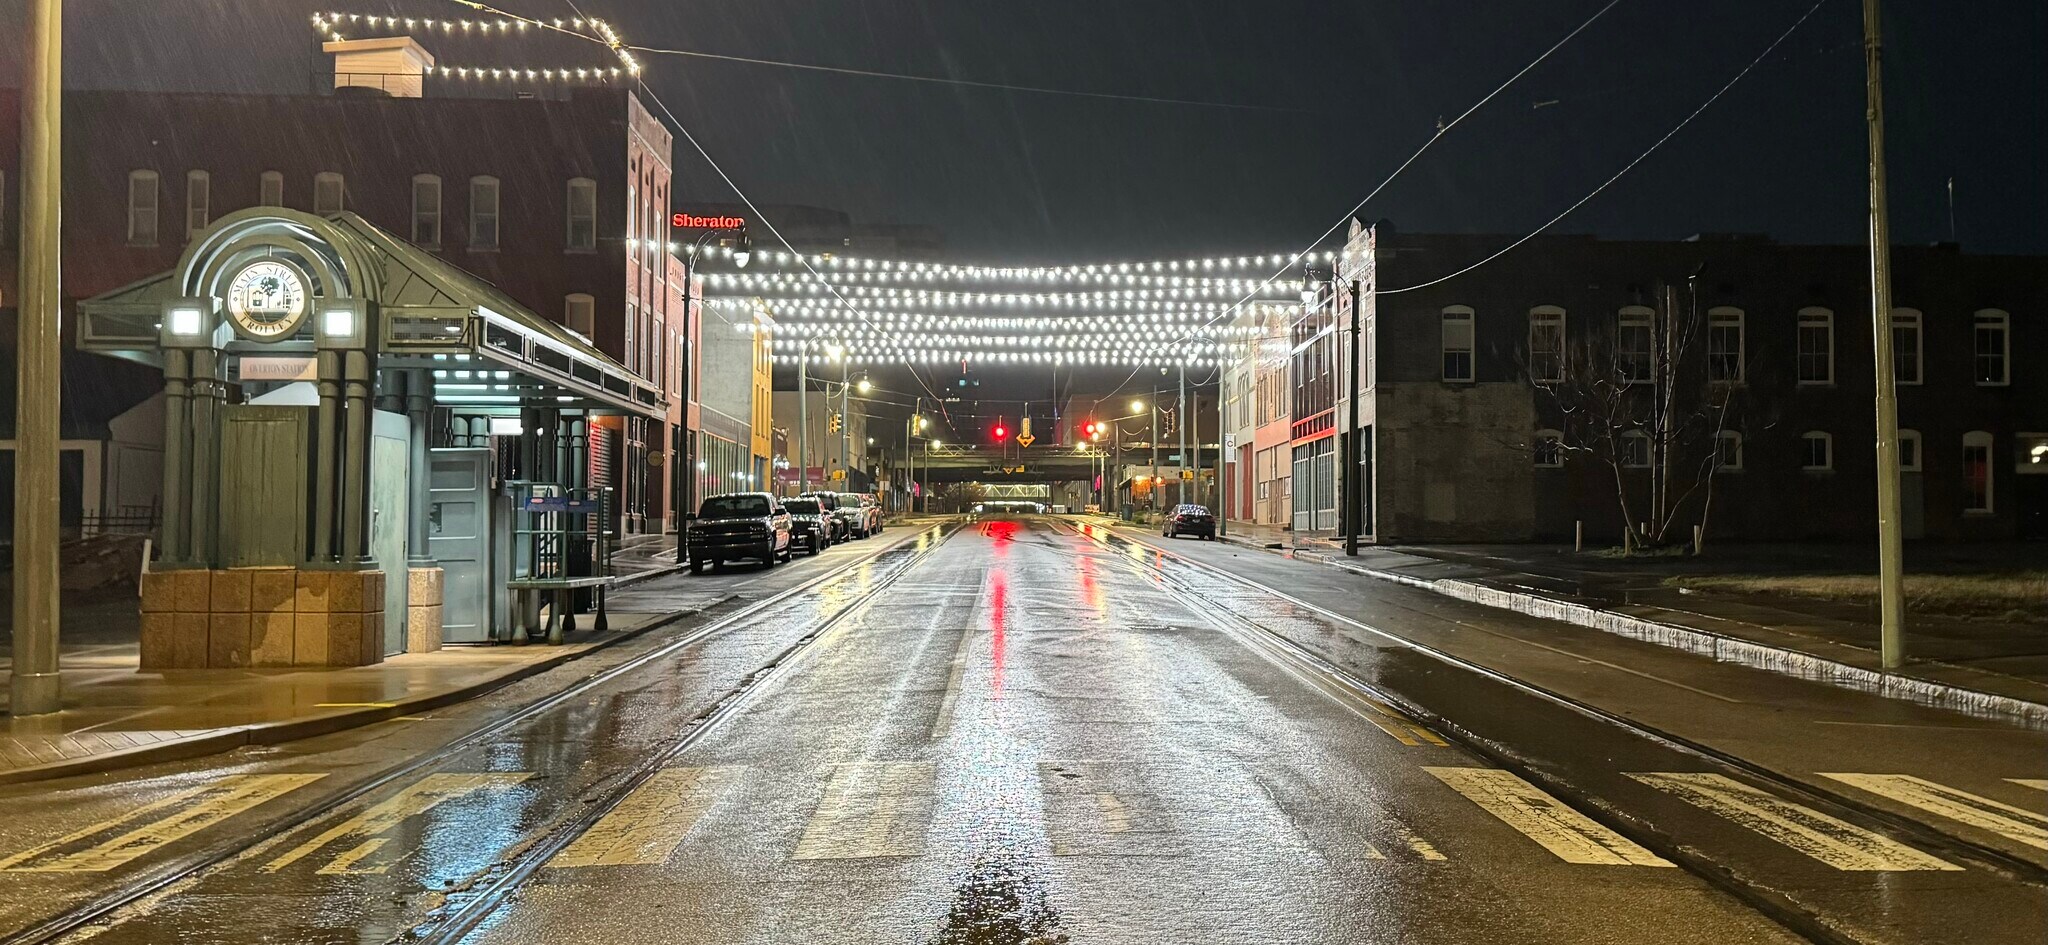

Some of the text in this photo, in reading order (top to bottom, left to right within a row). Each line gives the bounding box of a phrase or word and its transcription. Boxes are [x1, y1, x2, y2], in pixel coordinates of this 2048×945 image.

[673, 214, 744, 228] Sheraton
[234, 267, 301, 293] MAIN STREET
[240, 316, 293, 334] TROLLEY
[281, 364, 309, 374] STATION
